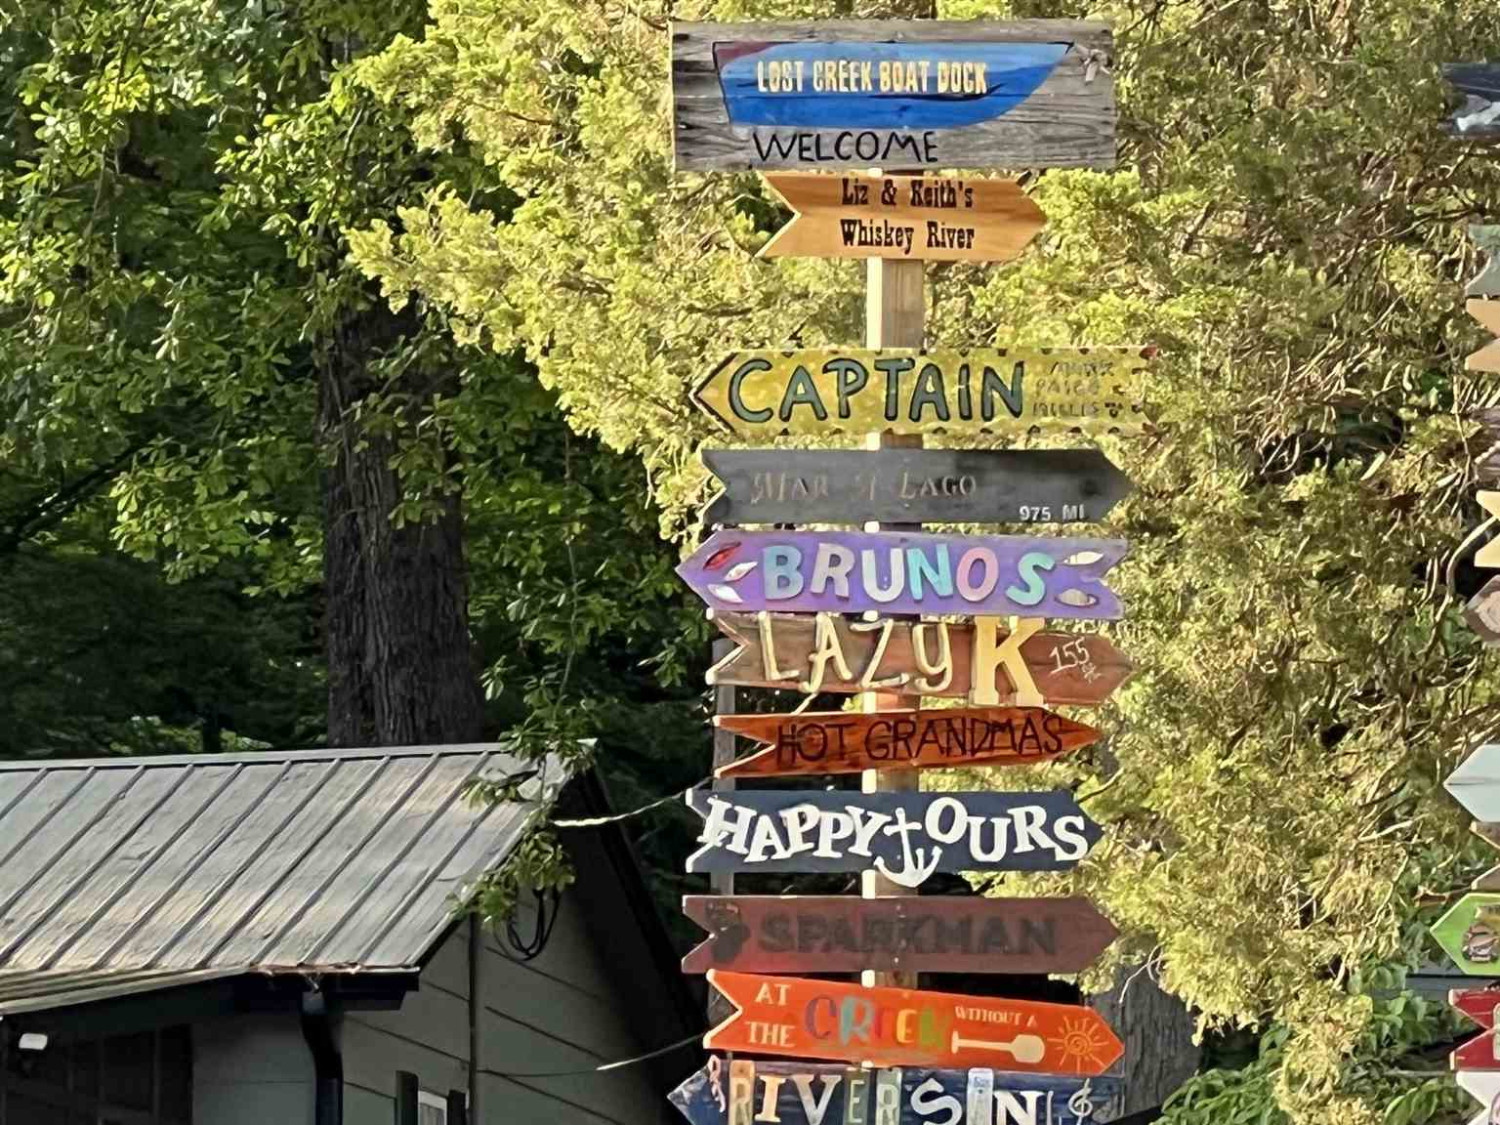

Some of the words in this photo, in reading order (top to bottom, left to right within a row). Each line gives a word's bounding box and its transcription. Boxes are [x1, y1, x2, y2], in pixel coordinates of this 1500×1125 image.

[757, 60, 803, 92] LOST
[813, 60, 872, 92] CREEK
[879, 61, 929, 93] BOAT
[937, 61, 987, 94] DOCK
[753, 131, 938, 163] WELCOME
[842, 178, 868, 207] Liz
[881, 181, 897, 206] &
[909, 179, 973, 208] Keith's
[841, 219, 914, 254] Whiskey
[927, 221, 974, 249] River
[728, 359, 1024, 422] CAPTAIN
[900, 470, 977, 500] LAGO
[1019, 506, 1050, 521] 975
[1062, 505, 1084, 519] MI
[762, 543, 1055, 605] BRUNOS
[970, 616, 1044, 706] K
[1048, 636, 1090, 676] 155
[777, 723, 858, 764] HOT
[699, 796, 885, 863] HAPPY
[928, 797, 1087, 862] OURS
[757, 915, 1055, 956] SPARKMAN
[755, 984, 791, 1006] AT
[954, 1005, 1021, 1026] WITHOUT
[1027, 1013, 1038, 1027] A
[746, 1021, 796, 1048] THE
